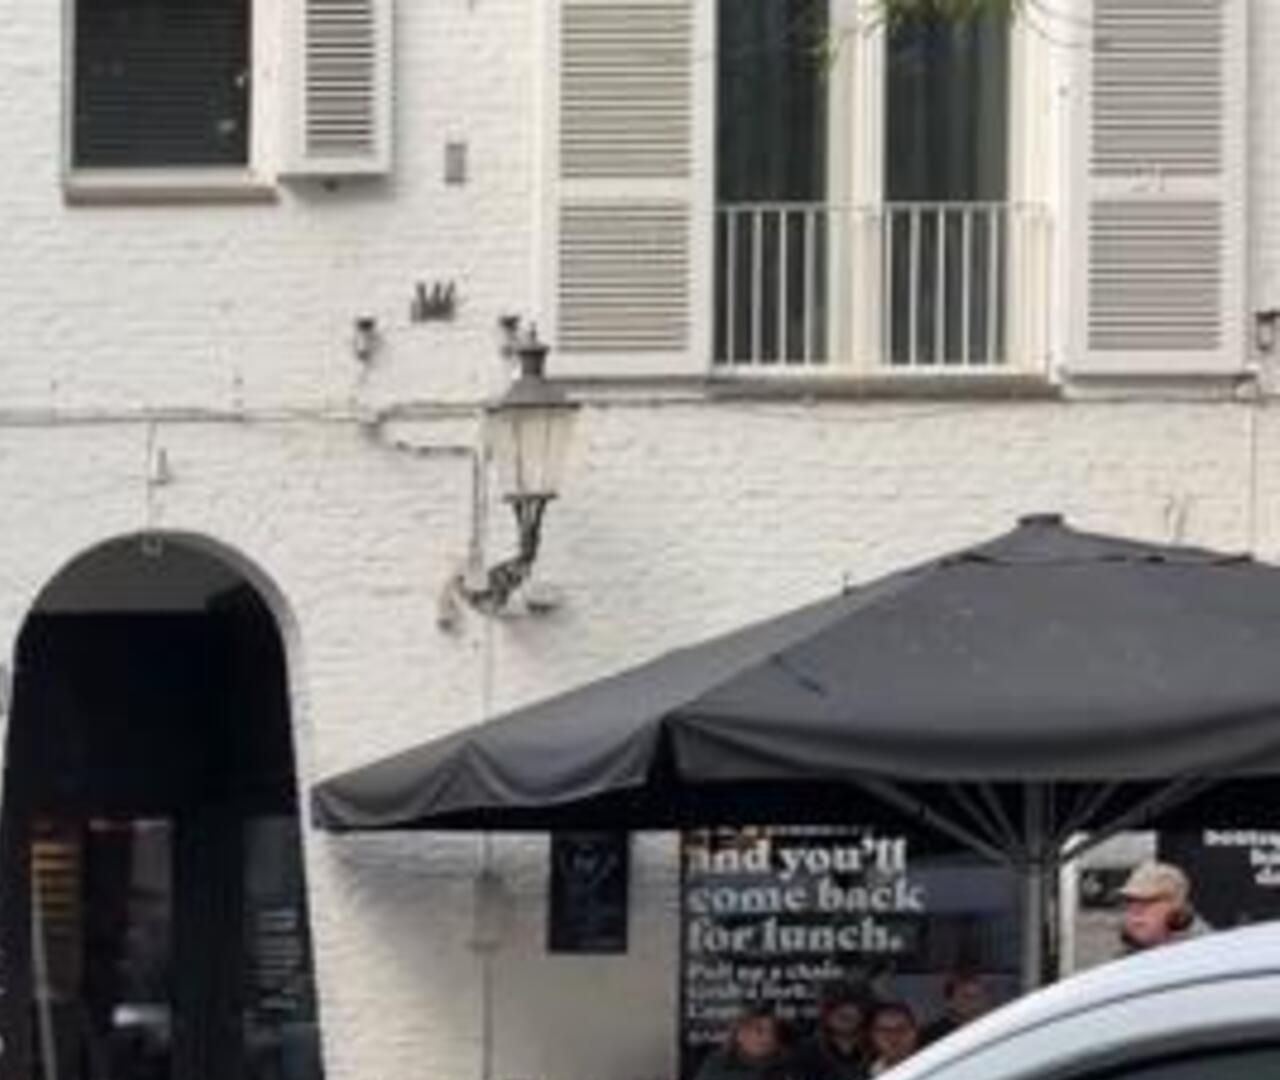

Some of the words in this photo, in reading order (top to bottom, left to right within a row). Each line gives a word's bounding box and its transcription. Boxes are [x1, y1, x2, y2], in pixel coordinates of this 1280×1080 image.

[688, 838, 772, 873] and
[779, 838, 907, 882] you'll
[688, 886, 808, 913] come
[816, 878, 925, 913] back
[690, 916, 754, 951] for
[763, 916, 902, 951] lunch.
